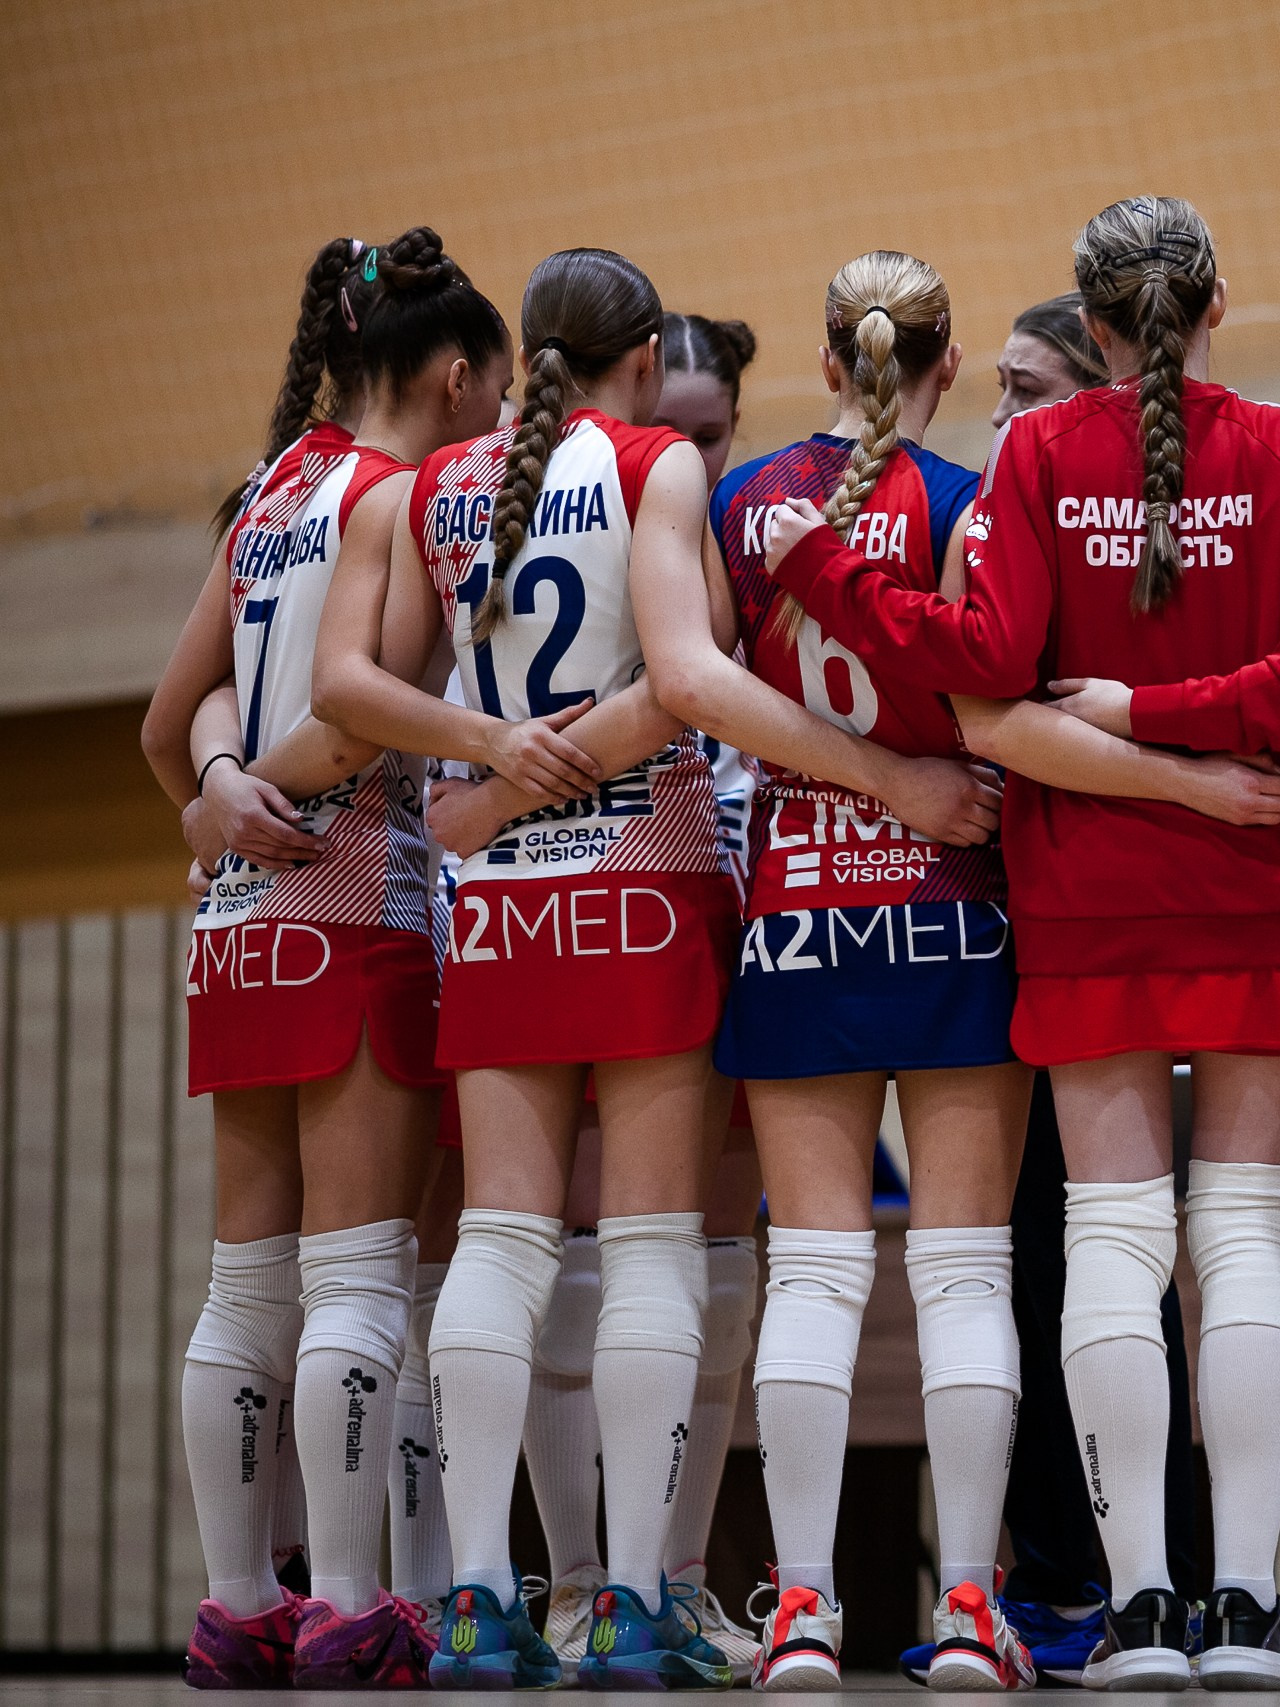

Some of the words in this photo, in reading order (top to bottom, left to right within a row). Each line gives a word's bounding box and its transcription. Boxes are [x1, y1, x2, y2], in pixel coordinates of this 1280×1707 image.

[435, 483, 608, 546] ВАСИНА
[1086, 535, 1234, 567] ОБЛСТЬ
[456, 556, 598, 720] 12
[243, 596, 280, 763] 7
[525, 826, 622, 847] GLOBAL
[525, 843, 606, 863] VISION
[769, 799, 942, 851] LIM
[832, 846, 940, 866] GLOBAL
[832, 865, 925, 883] VISION
[216, 895, 261, 913] VISION
[217, 876, 274, 897] GLOBAL
[186, 922, 331, 997] 2MED
[740, 901, 1008, 976] A2MED
[242, 1414, 259, 1484] adrenalina
[345, 1398, 366, 1473] adrenalina
[1086, 1433, 1102, 1495] adrenalina
[664, 1446, 682, 1504] adrenalina
